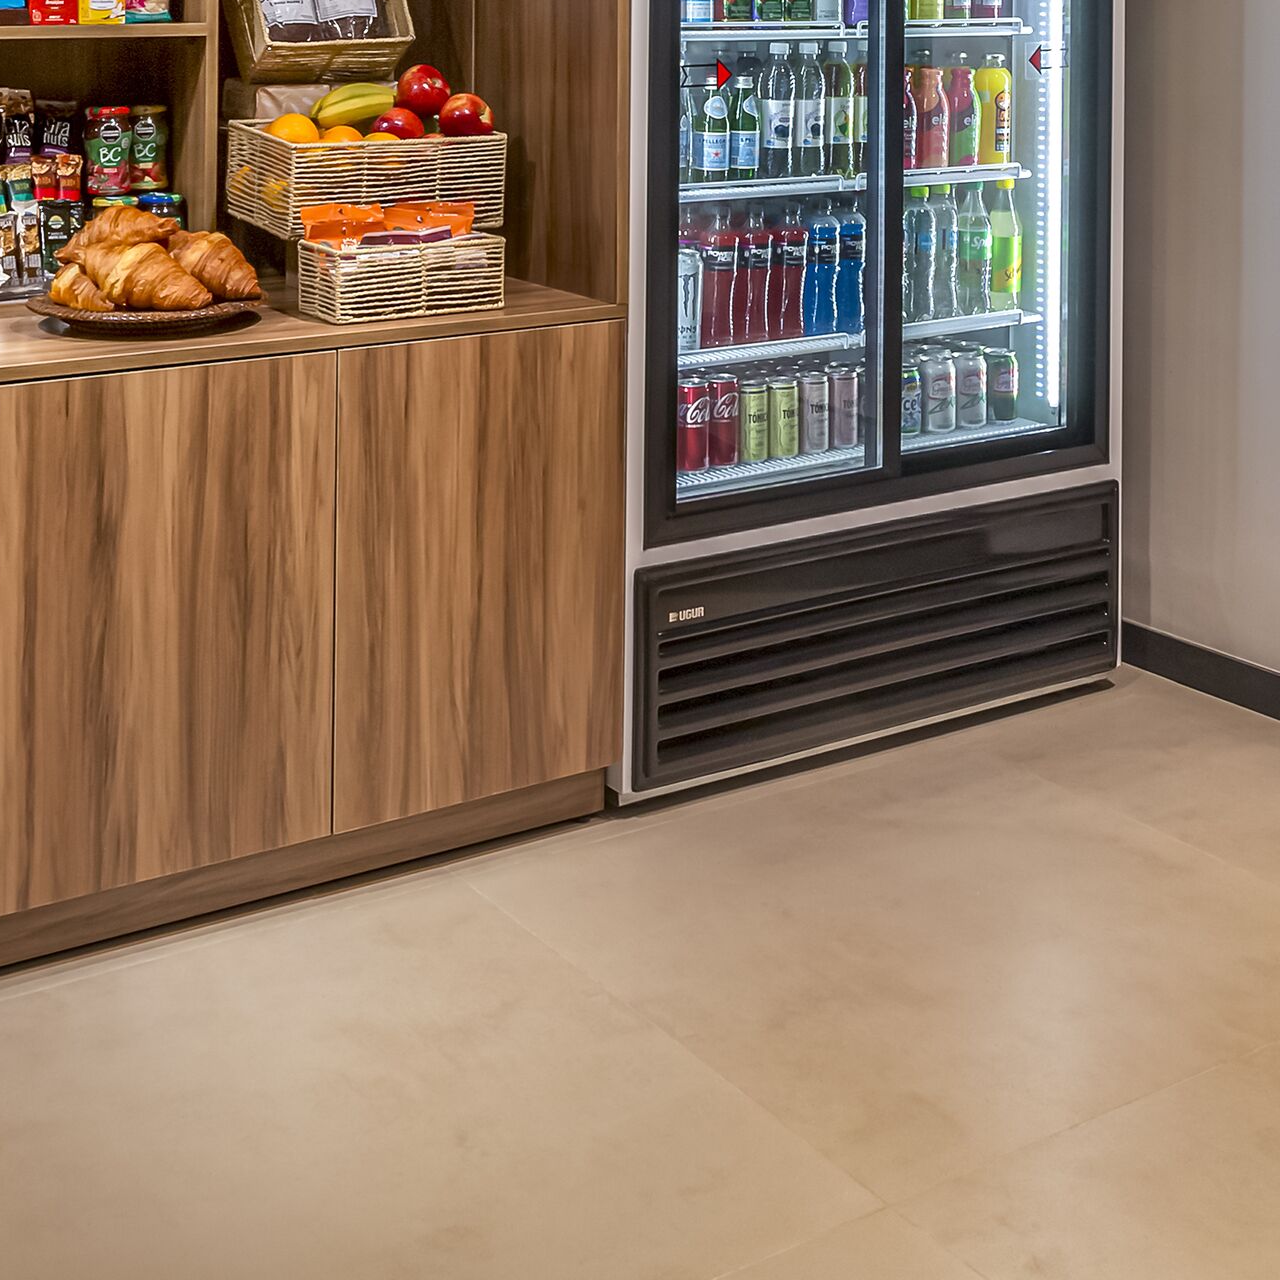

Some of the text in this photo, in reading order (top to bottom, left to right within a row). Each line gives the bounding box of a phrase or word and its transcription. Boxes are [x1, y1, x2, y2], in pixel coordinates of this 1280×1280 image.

[43, 134, 69, 147] nuts
[99, 146, 121, 163] BC
[133, 142, 156, 159] BC
